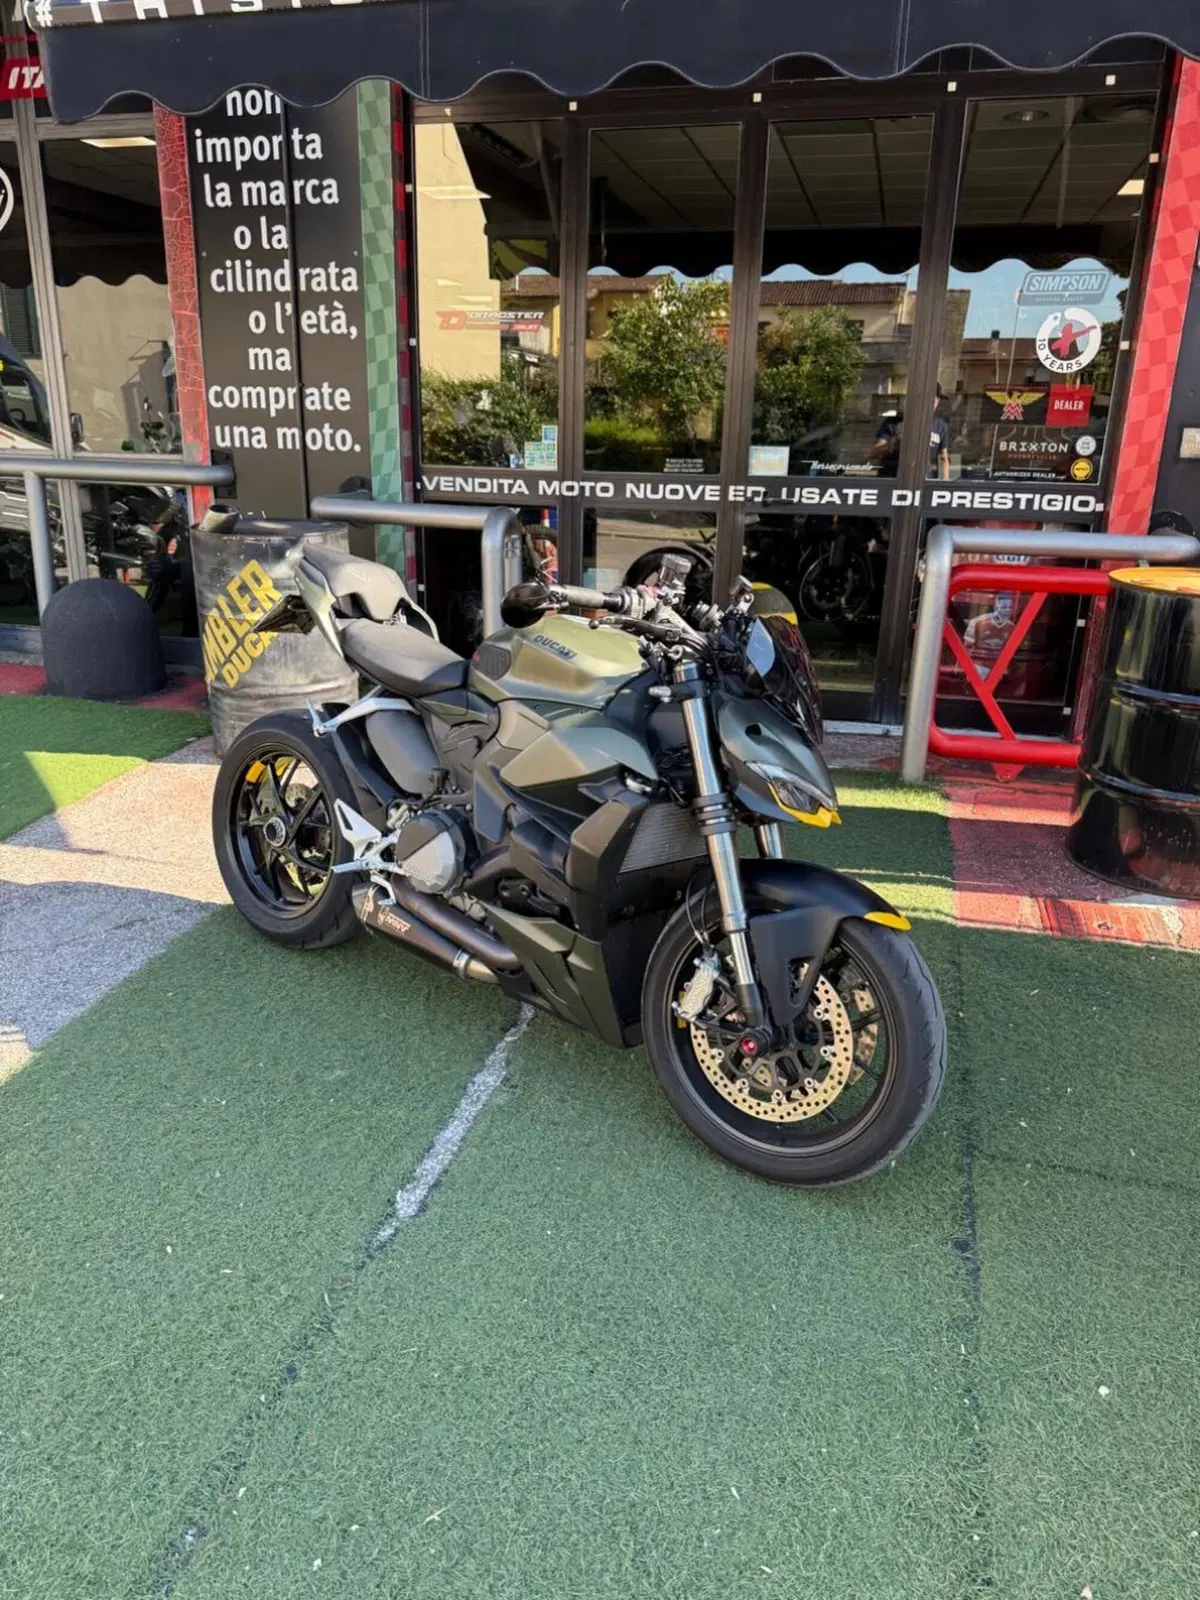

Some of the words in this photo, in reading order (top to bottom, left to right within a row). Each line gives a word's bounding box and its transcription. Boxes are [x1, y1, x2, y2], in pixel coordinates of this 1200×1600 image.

[226, 89, 281, 116] non
[194, 128, 323, 171] importa
[203, 173, 232, 208] la
[241, 178, 340, 206] marca
[234, 225, 251, 250] o
[260, 216, 289, 250] la
[210, 258, 359, 292] cilindrata
[1030, 274, 1100, 291] SIMPSON
[248, 310, 266, 334] o
[248, 347, 292, 371] ma
[1043, 354, 1083, 371] YEARS
[208, 381, 351, 418] comprate
[1053, 400, 1085, 411] DEALER
[215, 425, 267, 449] una
[276, 423, 362, 452] moto.
[1000, 441, 1068, 453] BRIXTON
[422, 475, 530, 495] VENDITA
[538, 480, 615, 498] MOTO
[625, 482, 721, 500] NUOVE
[728, 485, 767, 502] ED
[781, 487, 879, 506] USATE
[891, 489, 921, 507] DI
